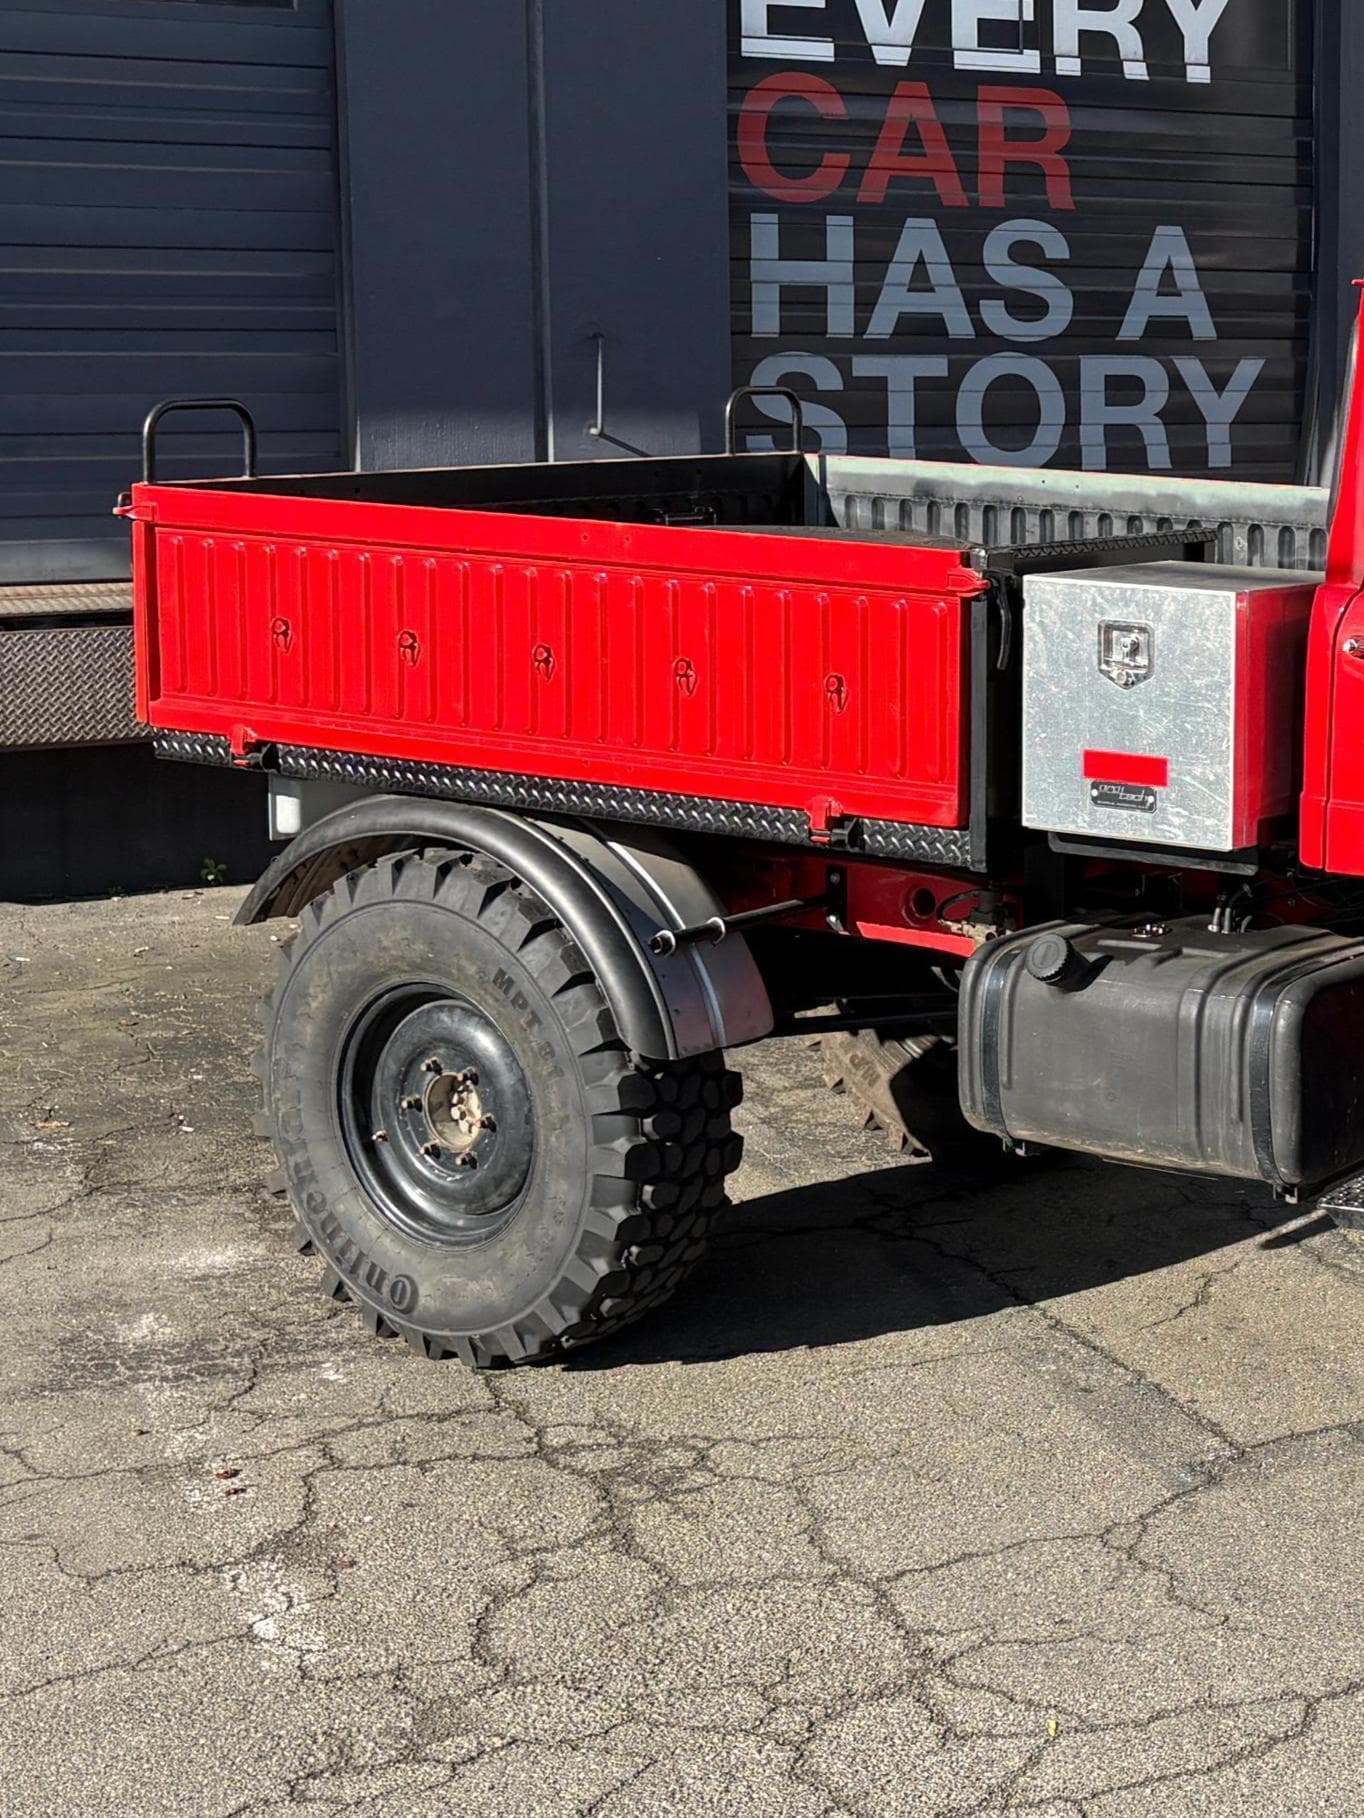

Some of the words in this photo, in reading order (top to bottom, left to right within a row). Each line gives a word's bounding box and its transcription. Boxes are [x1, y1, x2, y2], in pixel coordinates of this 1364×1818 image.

[740, 0, 1229, 83] EVERY
[737, 72, 1076, 210] CAR
[750, 213, 1075, 342] HAS
[1115, 225, 1218, 341] A
[745, 351, 1267, 470] STORY
